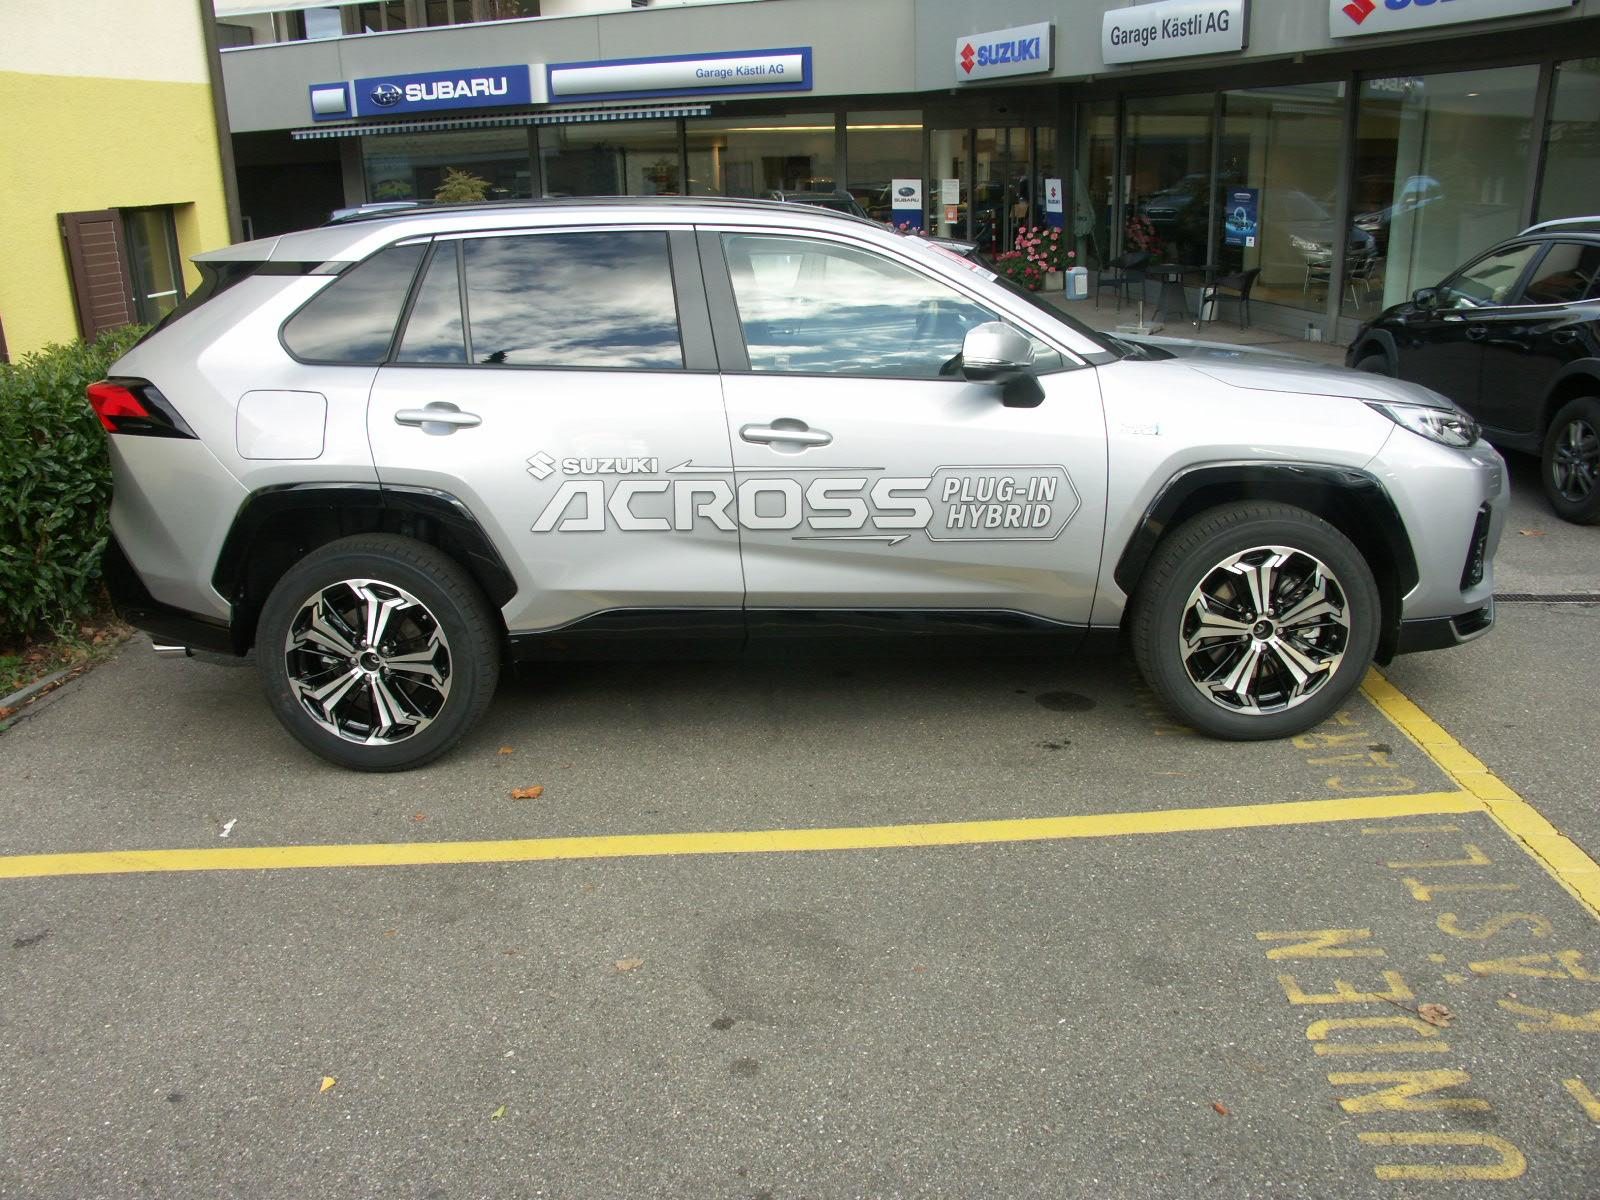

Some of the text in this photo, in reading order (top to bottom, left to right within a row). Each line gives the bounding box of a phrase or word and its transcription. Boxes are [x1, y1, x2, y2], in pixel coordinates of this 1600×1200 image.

[1110, 9, 1230, 47] Garage Kästli AG
[977, 37, 1040, 67] SUZUKI
[695, 63, 785, 79] Garage Kästli AG
[405, 76, 508, 102] SUBARU
[561, 457, 658, 475] SUZUKI
[942, 476, 1058, 502] PLUG-IN
[530, 476, 935, 532] ACROSS
[946, 504, 1052, 529] HYBRID
